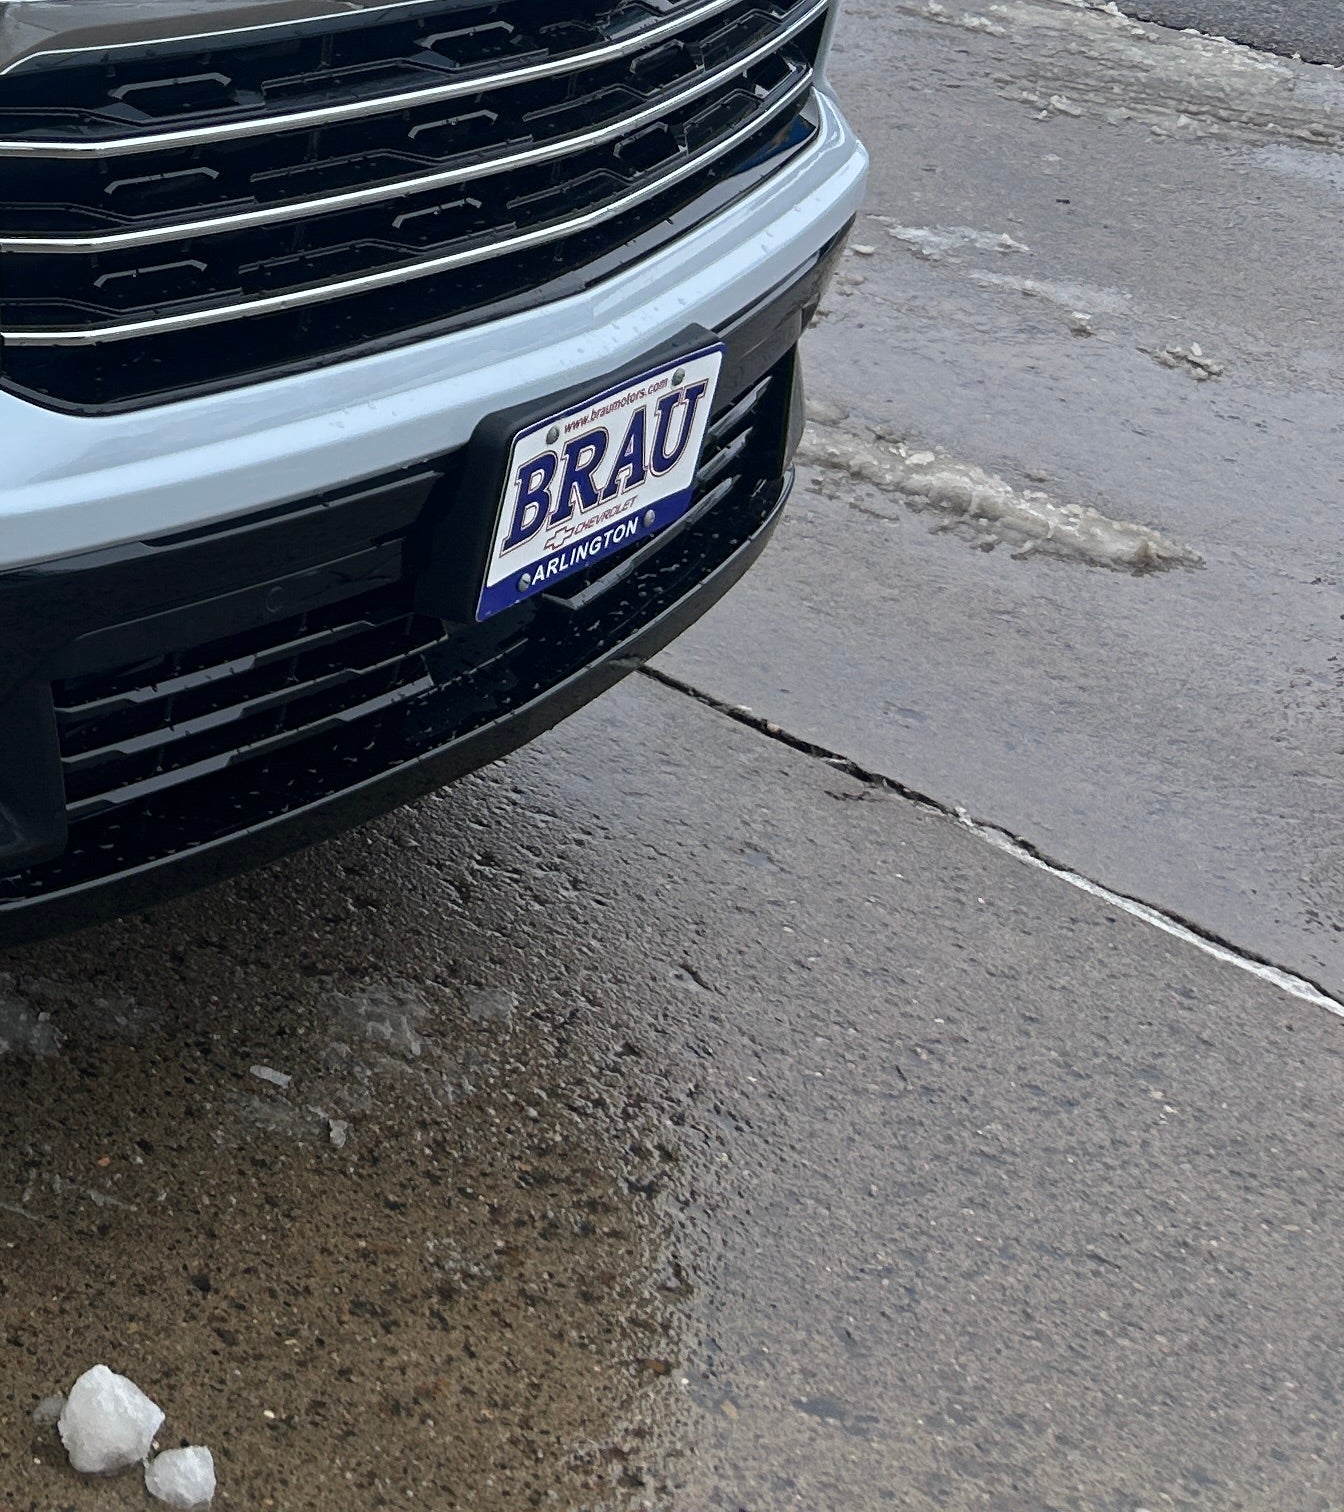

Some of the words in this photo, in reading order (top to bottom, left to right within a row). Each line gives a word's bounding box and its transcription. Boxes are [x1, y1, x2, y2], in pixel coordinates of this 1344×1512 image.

[564, 378, 668, 434] www.braumotors.com
[499, 378, 709, 558] BRAU
[573, 495, 638, 535] CHEVROLET
[532, 516, 639, 586] ARLINGTON
